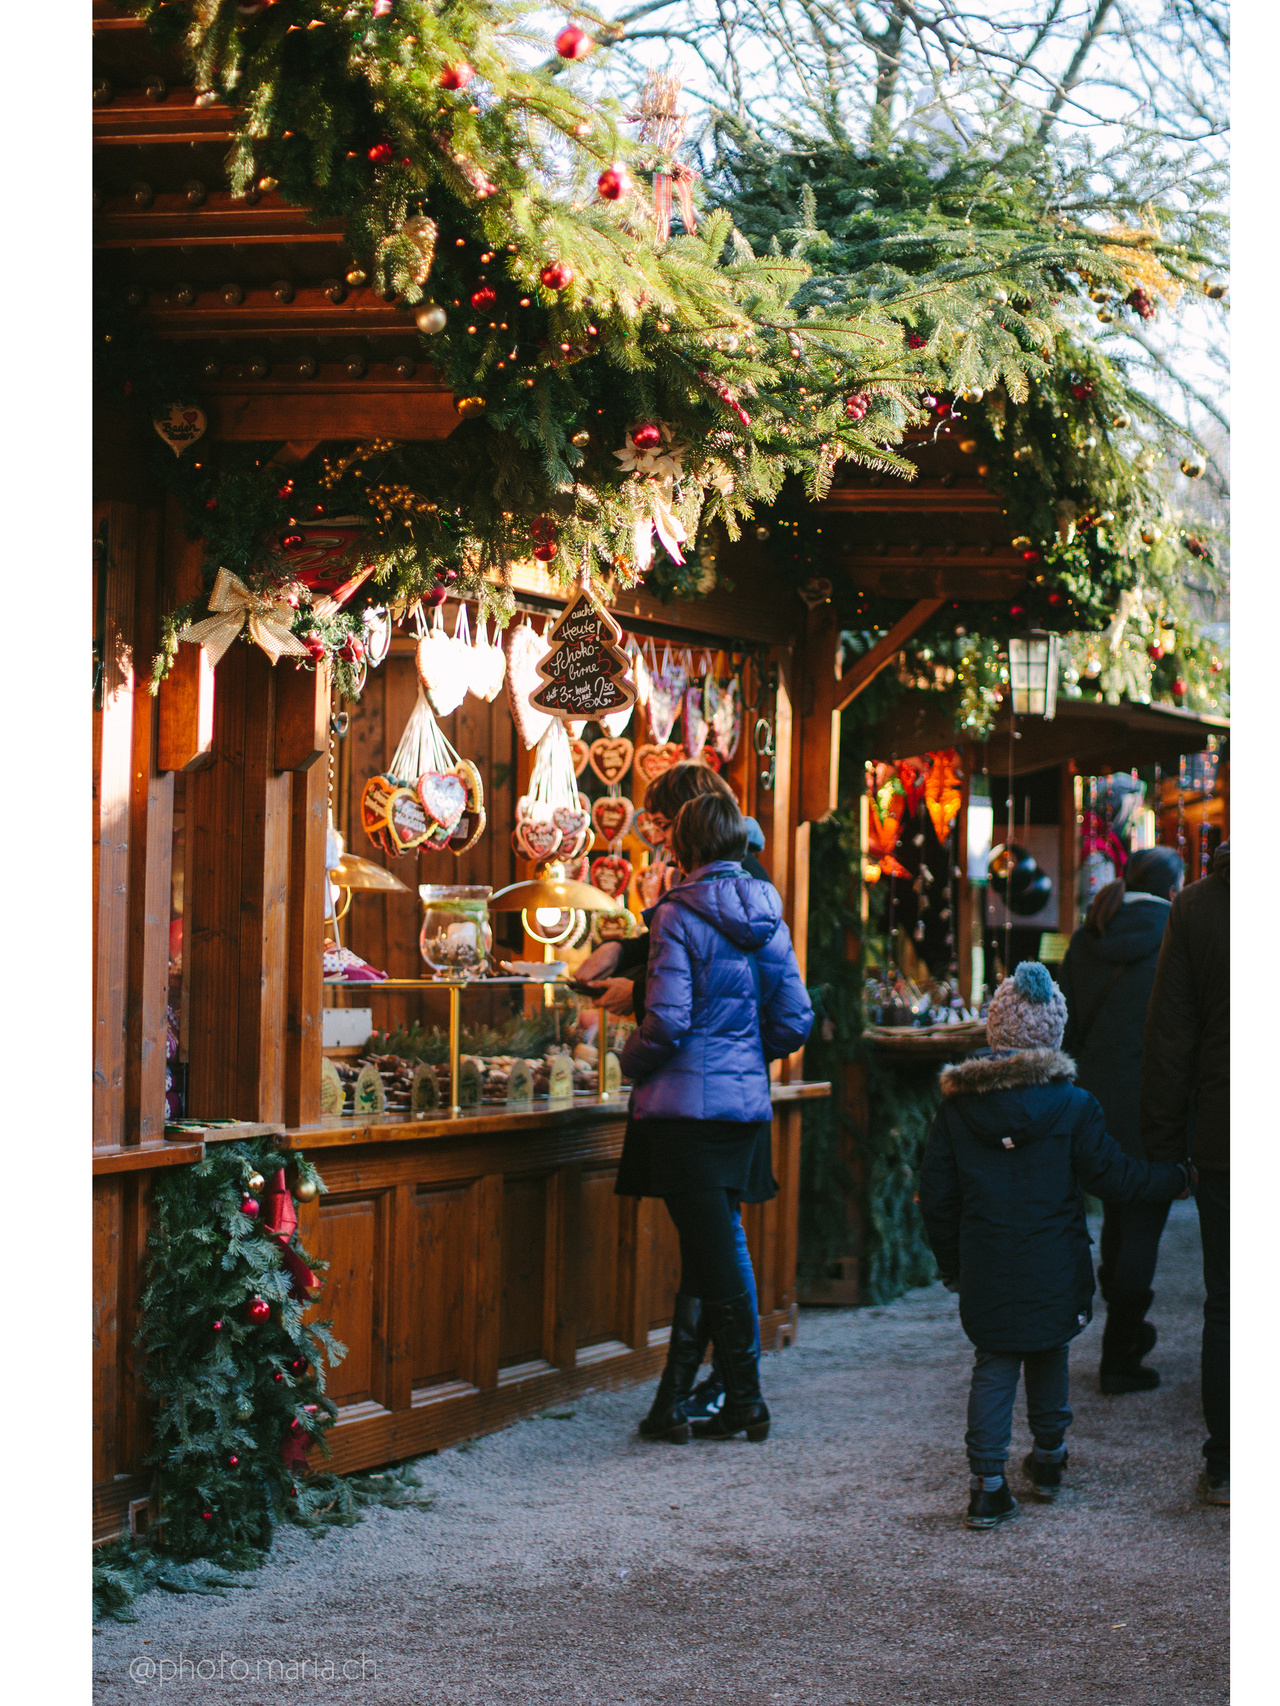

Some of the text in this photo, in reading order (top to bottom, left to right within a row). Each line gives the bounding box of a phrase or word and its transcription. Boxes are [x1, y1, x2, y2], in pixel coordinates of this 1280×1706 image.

[162, 422, 201, 433] Baden
[571, 604, 594, 619] auch
[562, 619, 602, 642] Heute!
[550, 641, 600, 676] Schoko-
[569, 662, 600, 680] birne
